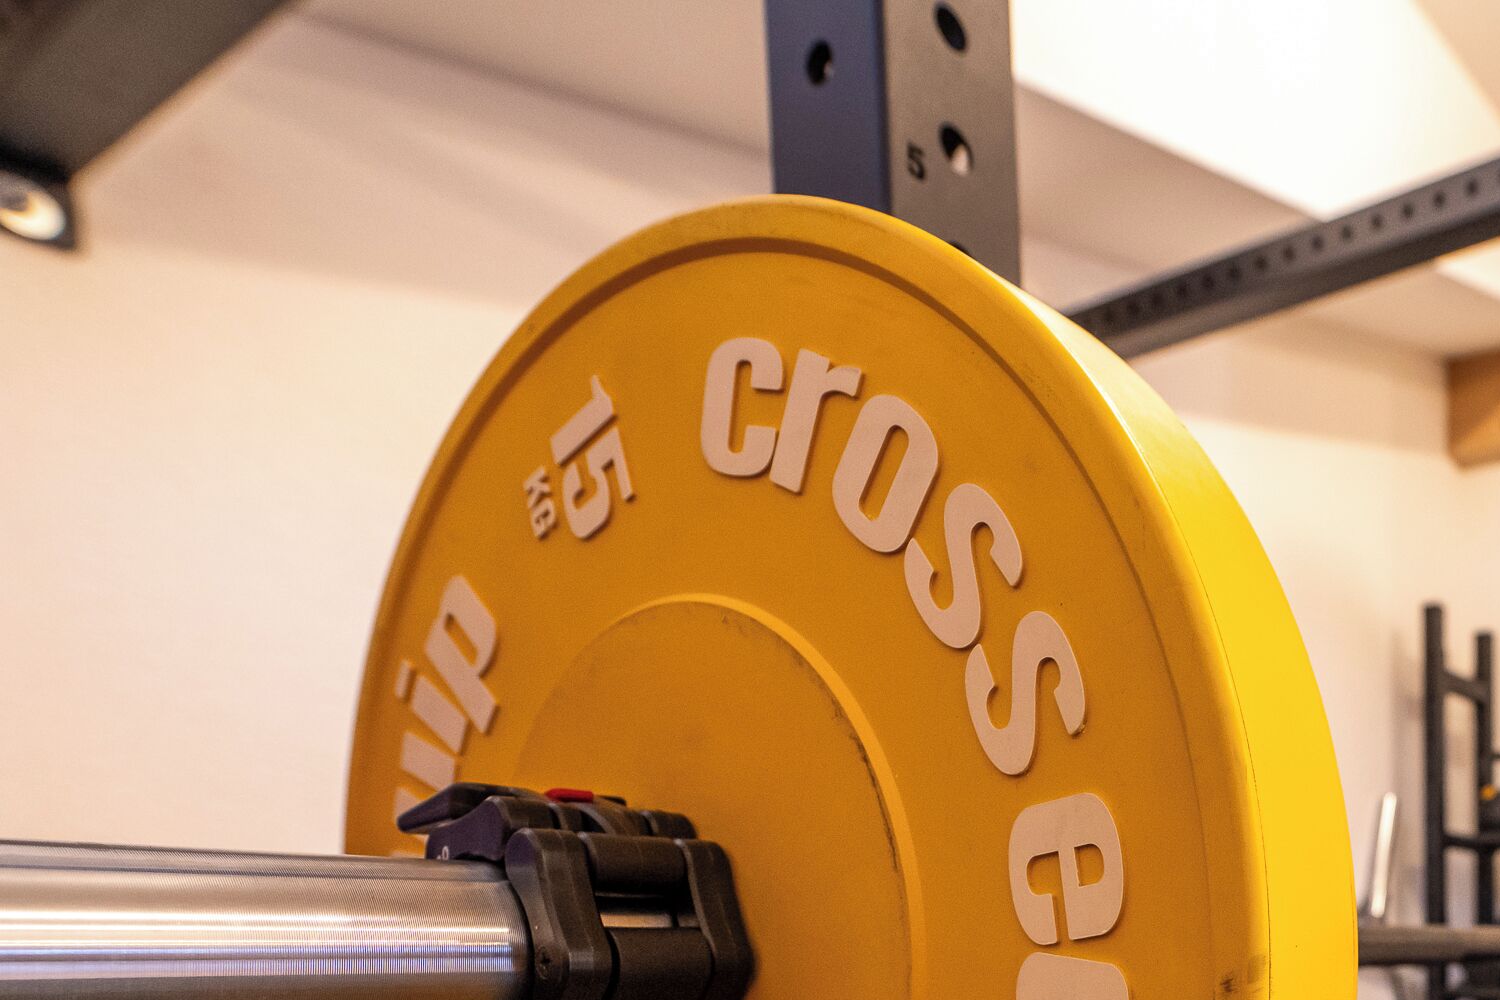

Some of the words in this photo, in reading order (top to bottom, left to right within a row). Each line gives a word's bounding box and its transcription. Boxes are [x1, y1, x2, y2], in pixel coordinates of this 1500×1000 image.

[906, 140, 928, 182] 5
[523, 466, 558, 539] KG
[550, 374, 633, 539] 15
[700, 337, 1086, 776] cross
